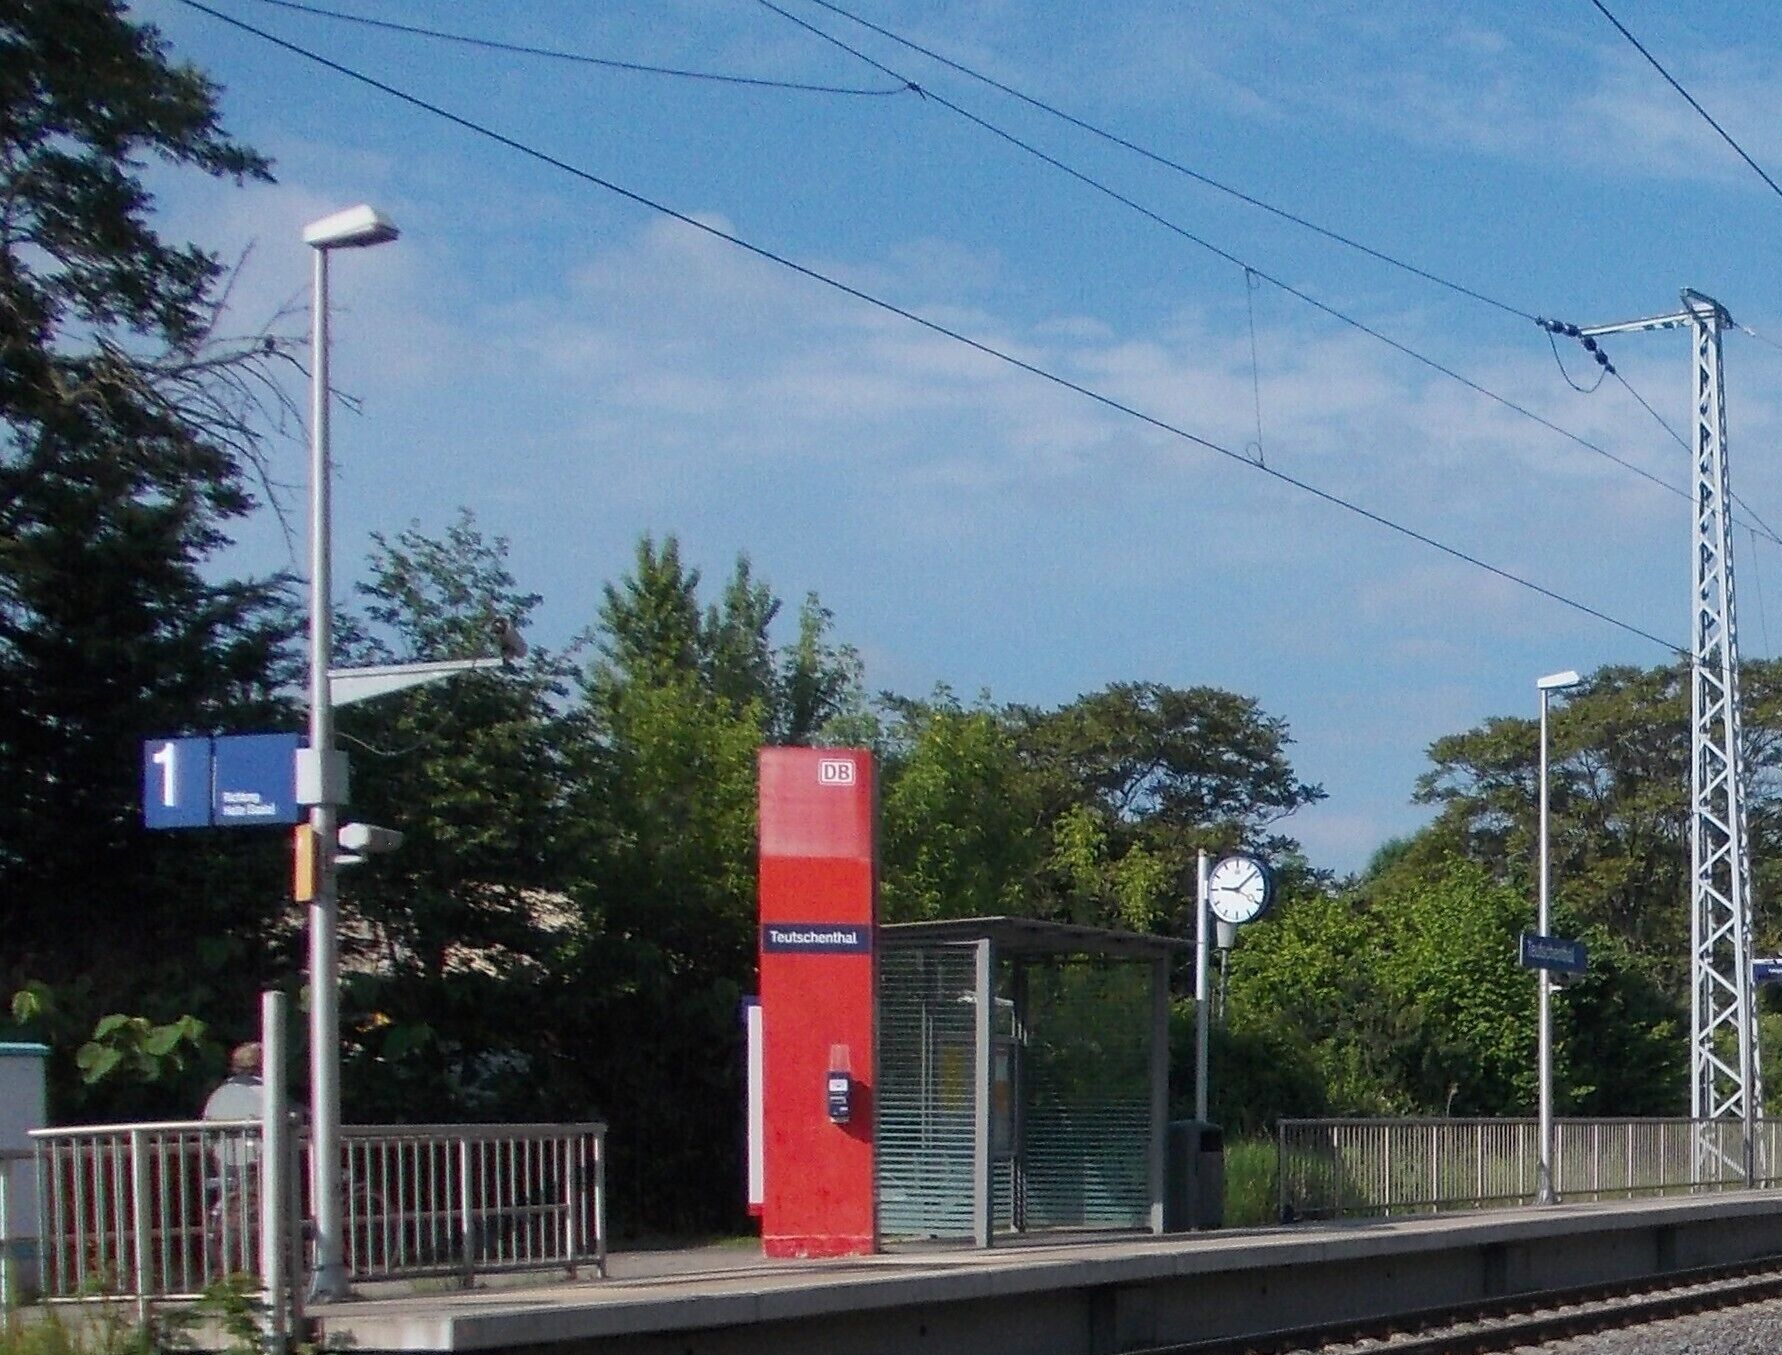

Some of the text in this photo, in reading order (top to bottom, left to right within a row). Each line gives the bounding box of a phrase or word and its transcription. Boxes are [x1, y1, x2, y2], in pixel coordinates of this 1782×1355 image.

[153, 743, 175, 807] 1
[823, 764, 850, 780] DB
[770, 930, 858, 945] Teutschenthal
